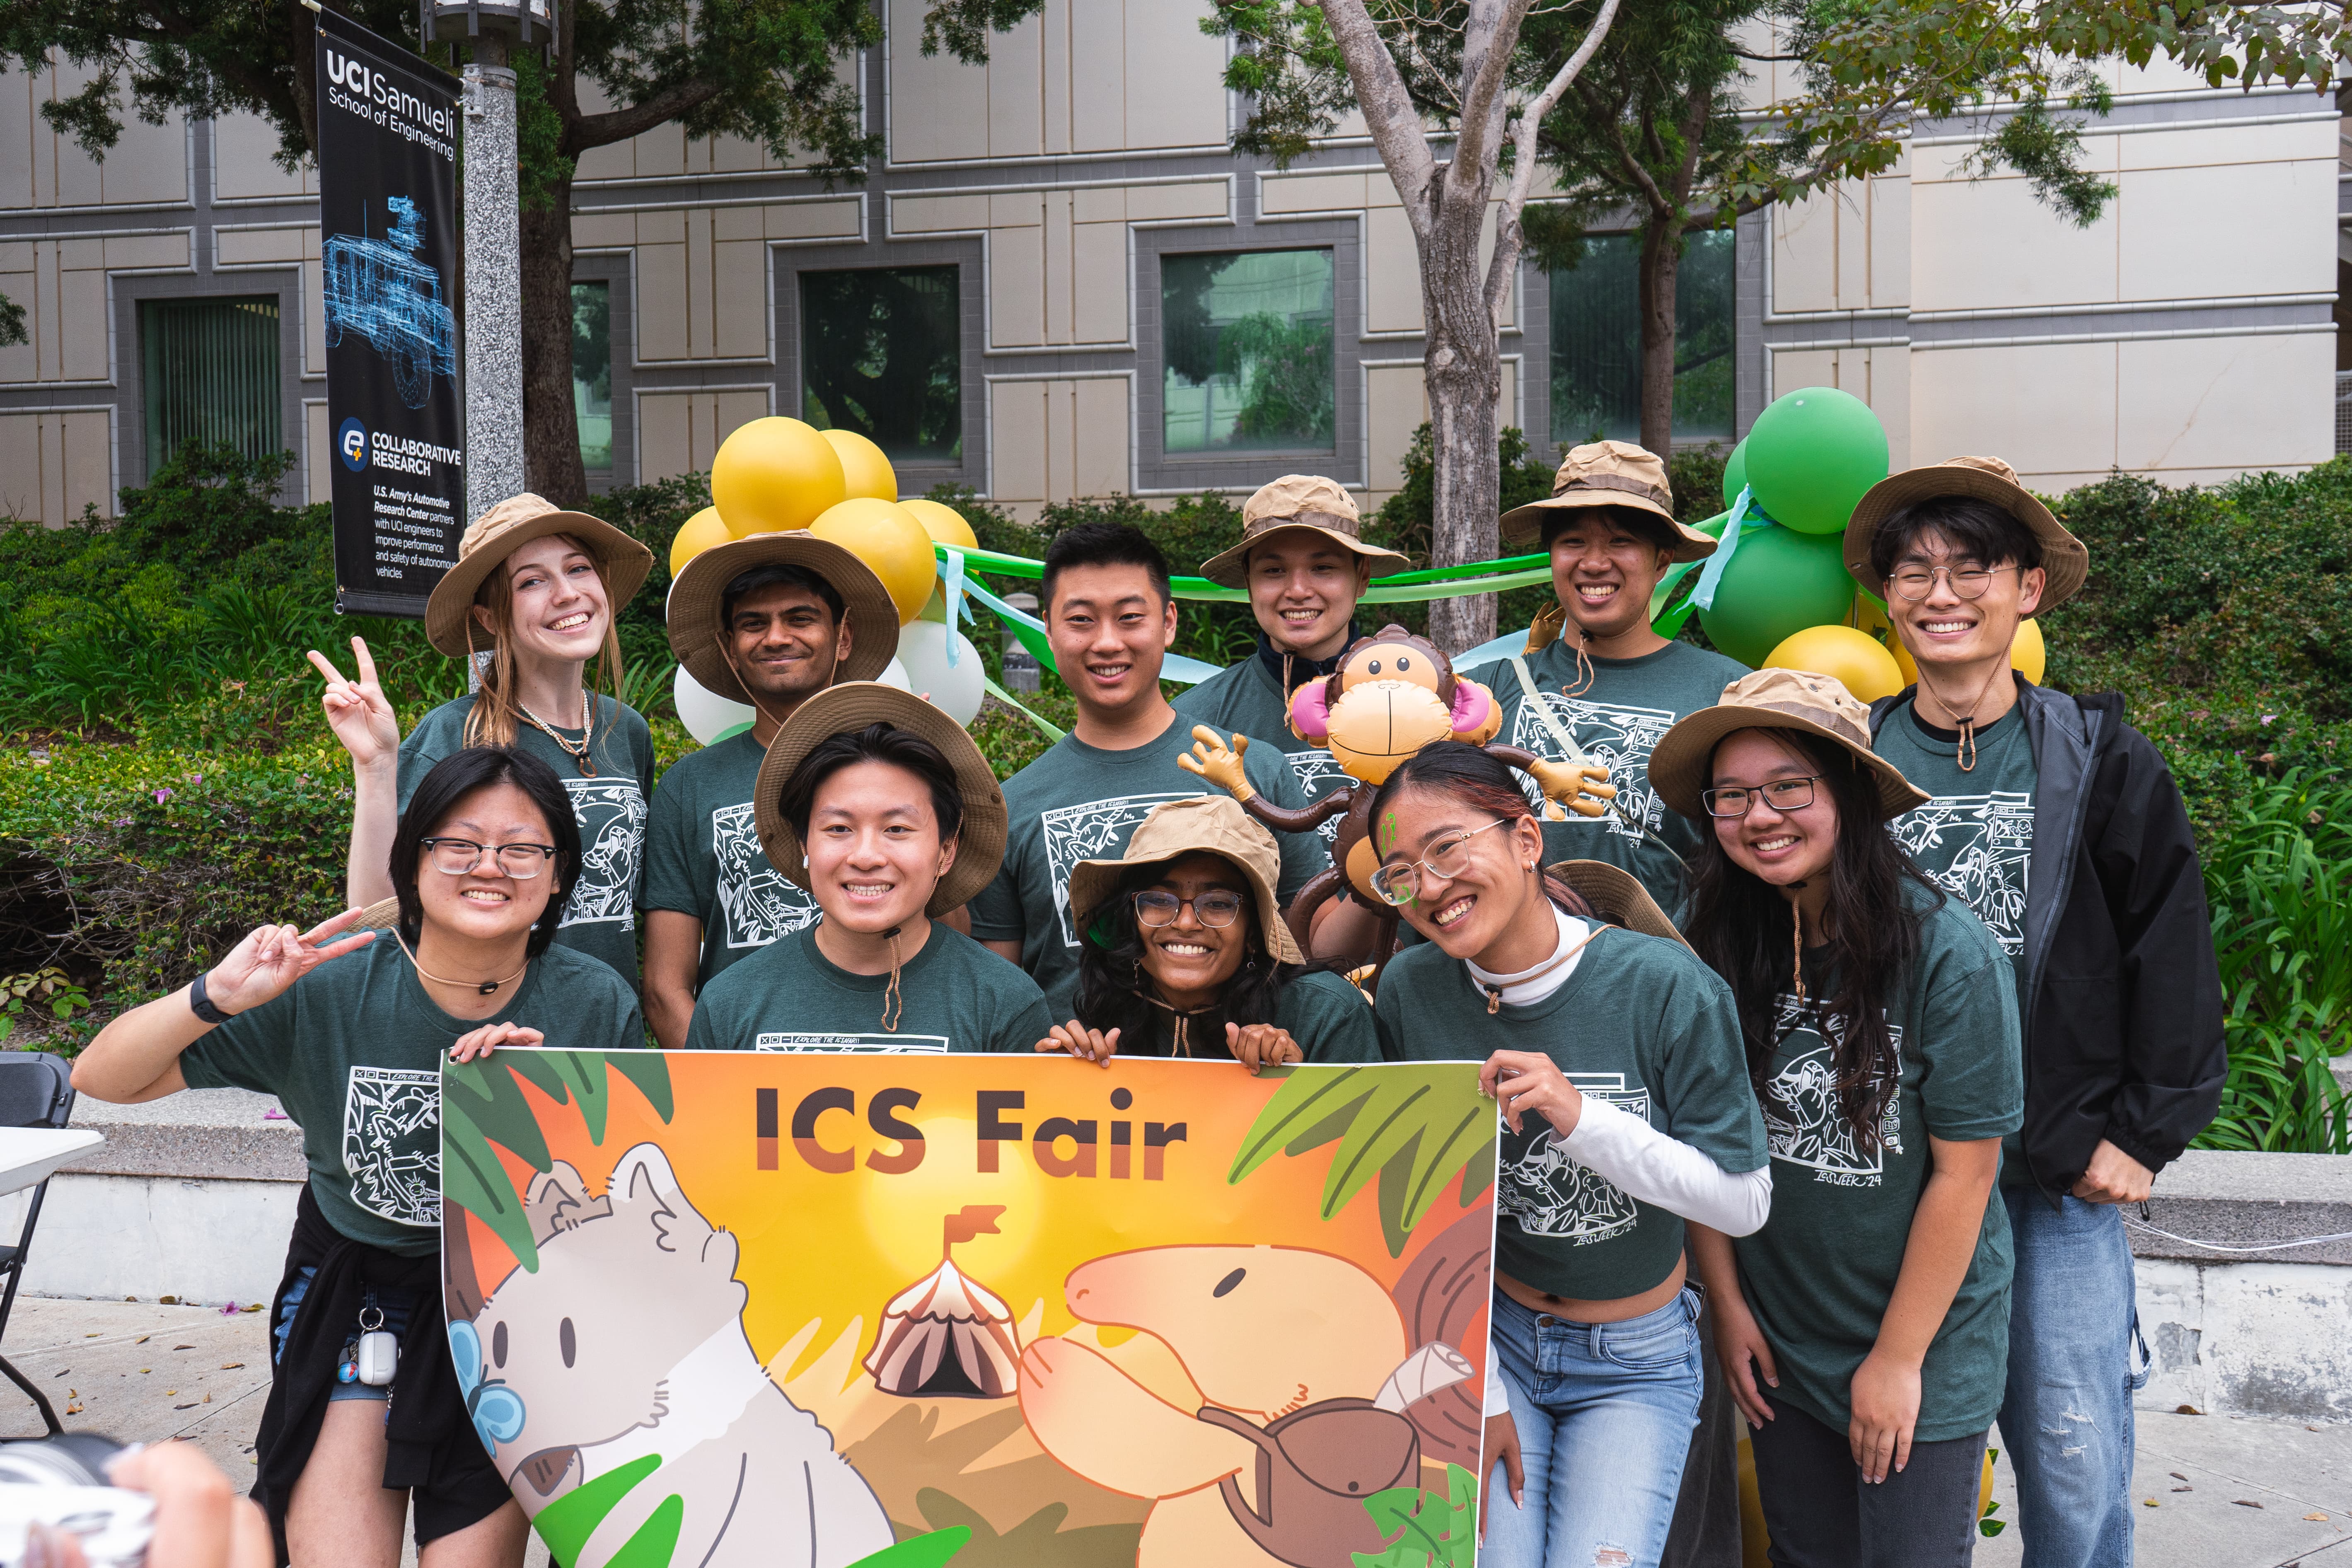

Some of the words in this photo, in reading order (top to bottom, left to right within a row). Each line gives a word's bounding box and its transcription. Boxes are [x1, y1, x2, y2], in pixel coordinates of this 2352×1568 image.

[327, 49, 370, 98] UCI
[373, 73, 453, 138] Samueli
[329, 87, 371, 120] School
[374, 111, 387, 127] of
[390, 114, 453, 162] Engineering
[372, 431, 461, 466] COLLABORATIVE
[373, 449, 430, 476] RESEARCH
[374, 485, 387, 498] U.S.
[389, 488, 412, 503] Army's
[412, 492, 450, 509] Automotive
[374, 501, 405, 516] Research
[406, 507, 429, 520] Center
[430, 512, 454, 525] partners
[375, 518, 389, 530] with
[391, 519, 403, 532] UCI
[404, 524, 435, 537] engineers
[436, 527, 443, 538] to
[375, 533, 402, 547] improve
[403, 539, 444, 553] performance
[375, 550, 389, 561] and
[390, 551, 409, 566] safety
[411, 554, 418, 565] of
[376, 565, 402, 579] vehicles
[1075, 805, 1097, 814] EXPLORE
[756, 1086, 926, 1174] ICS
[977, 1087, 1187, 1181] Fair
